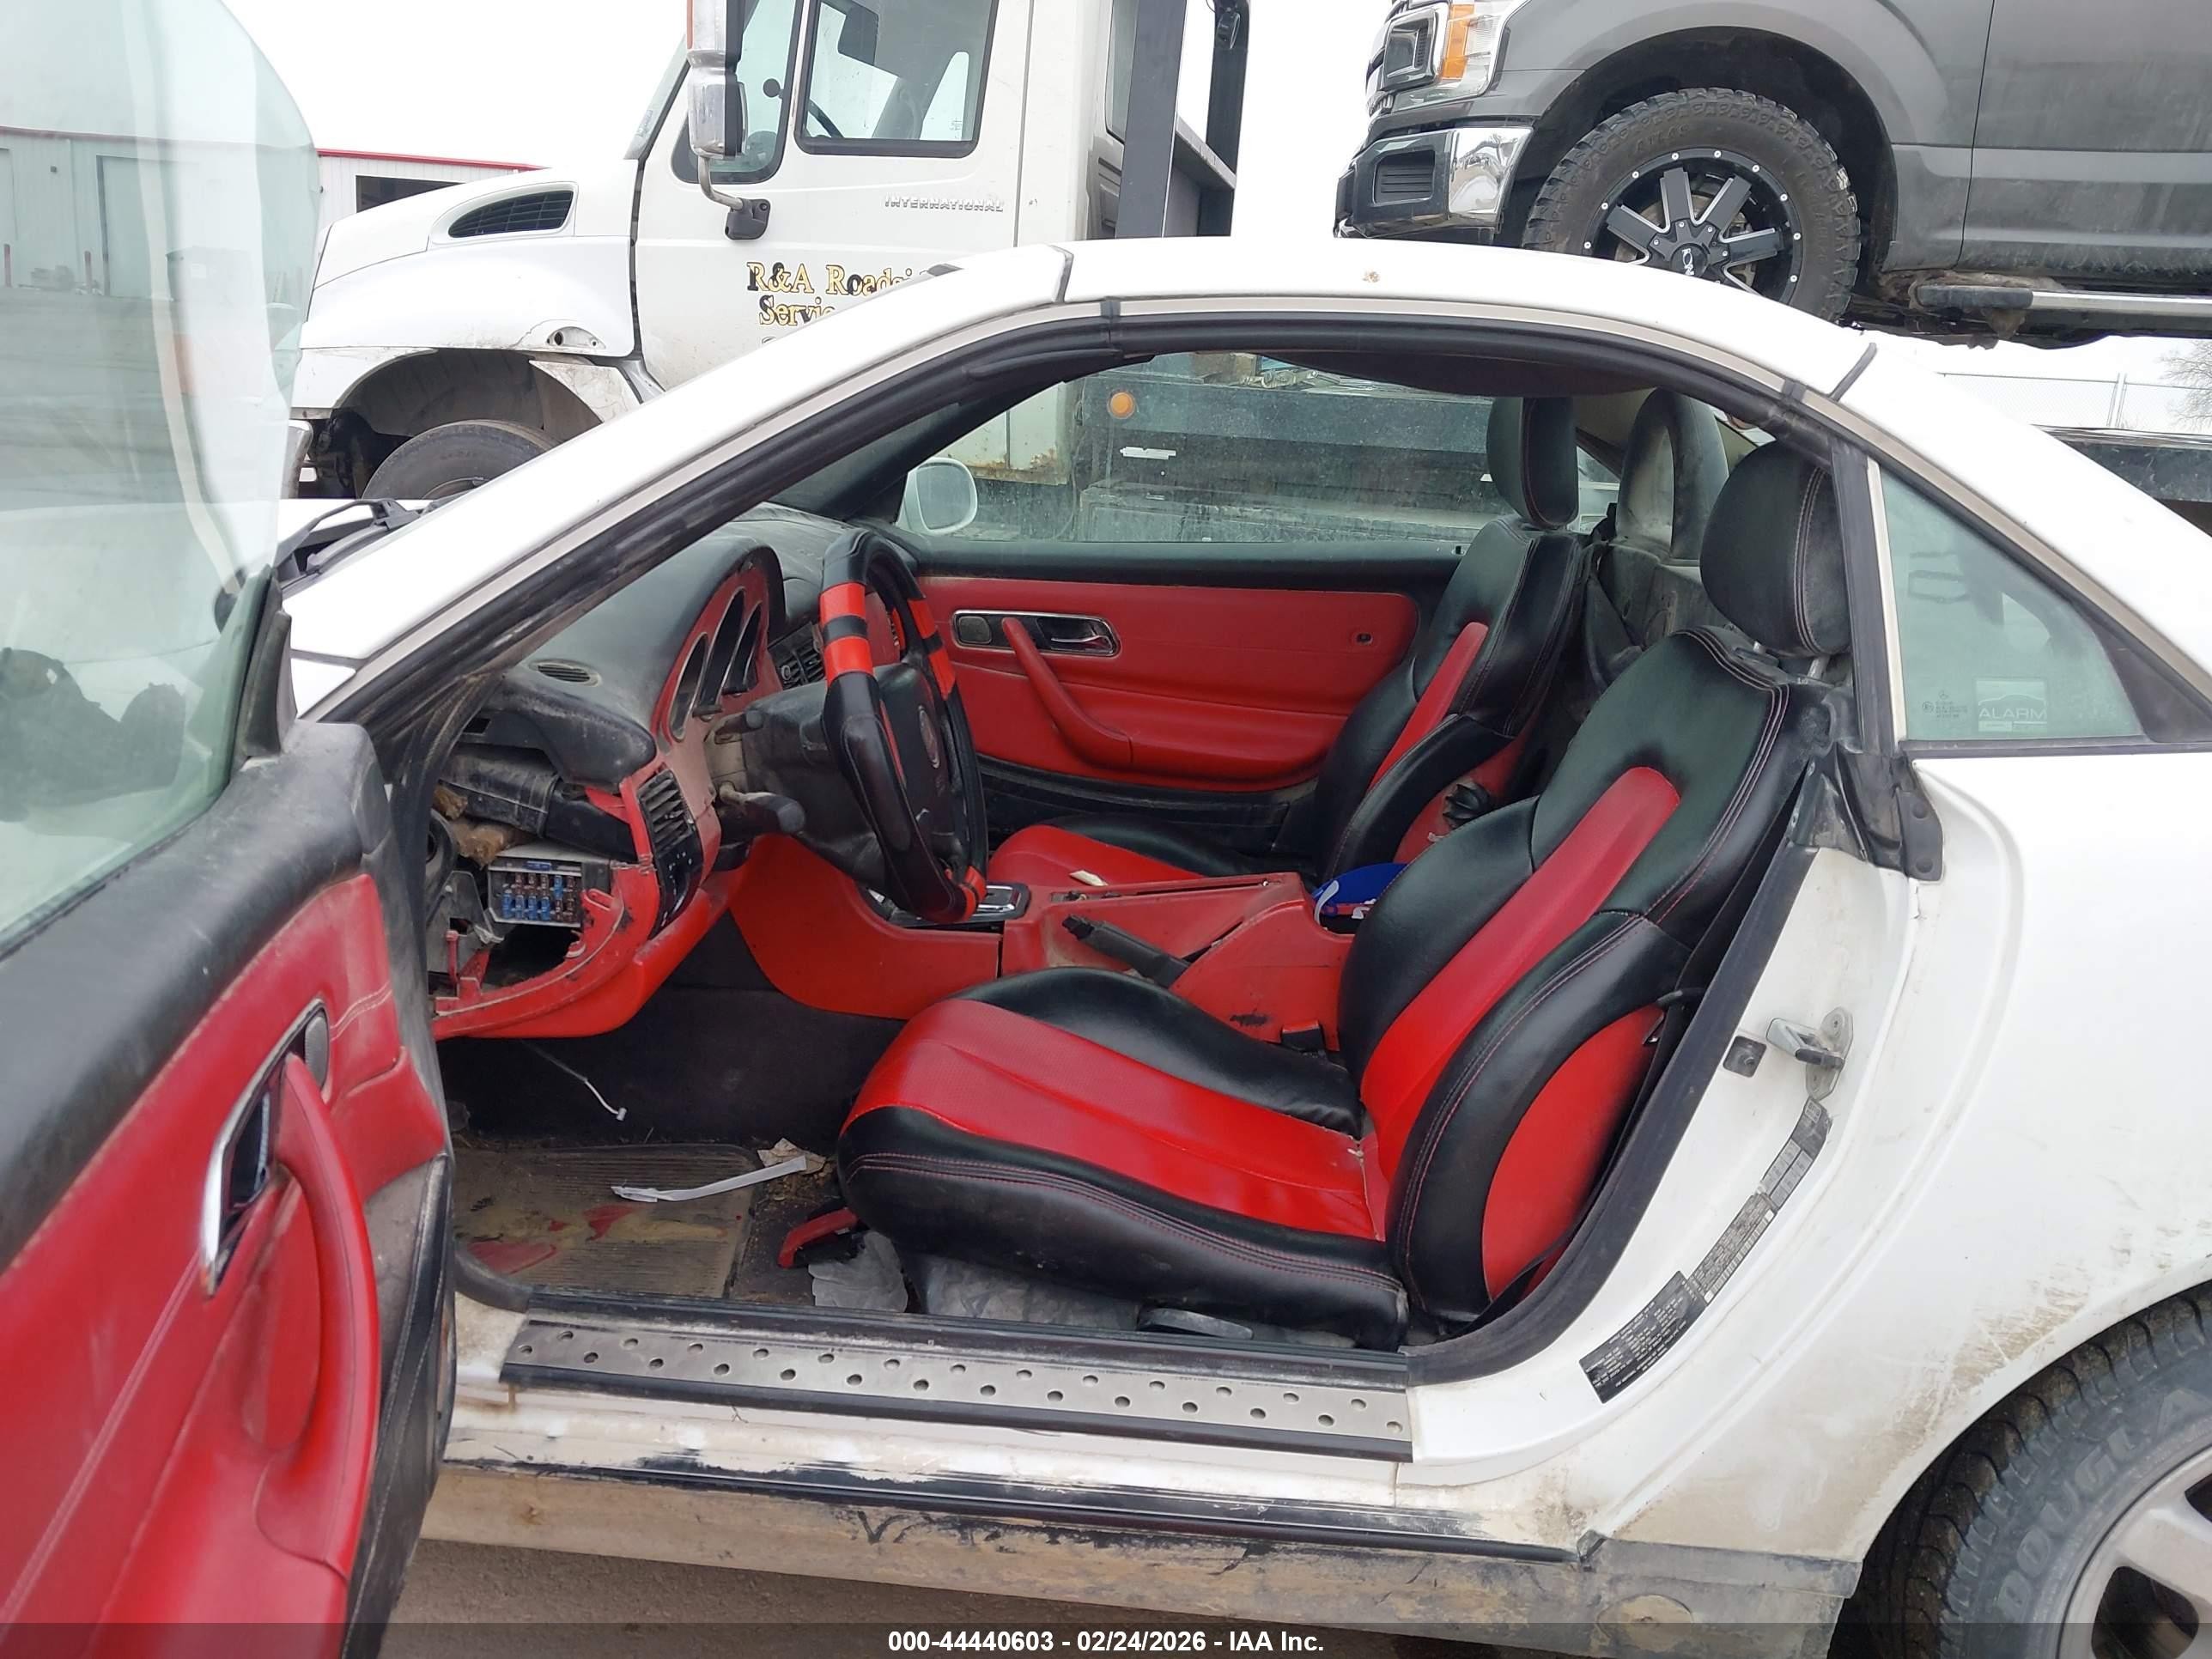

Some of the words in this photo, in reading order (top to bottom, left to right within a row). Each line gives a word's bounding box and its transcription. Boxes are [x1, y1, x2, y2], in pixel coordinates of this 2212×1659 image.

[884, 195, 1004, 212] INTERNATIONAL
[747, 262, 814, 293] R&A
[826, 264, 917, 295] Road
[1978, 708, 2047, 720] ALARM
